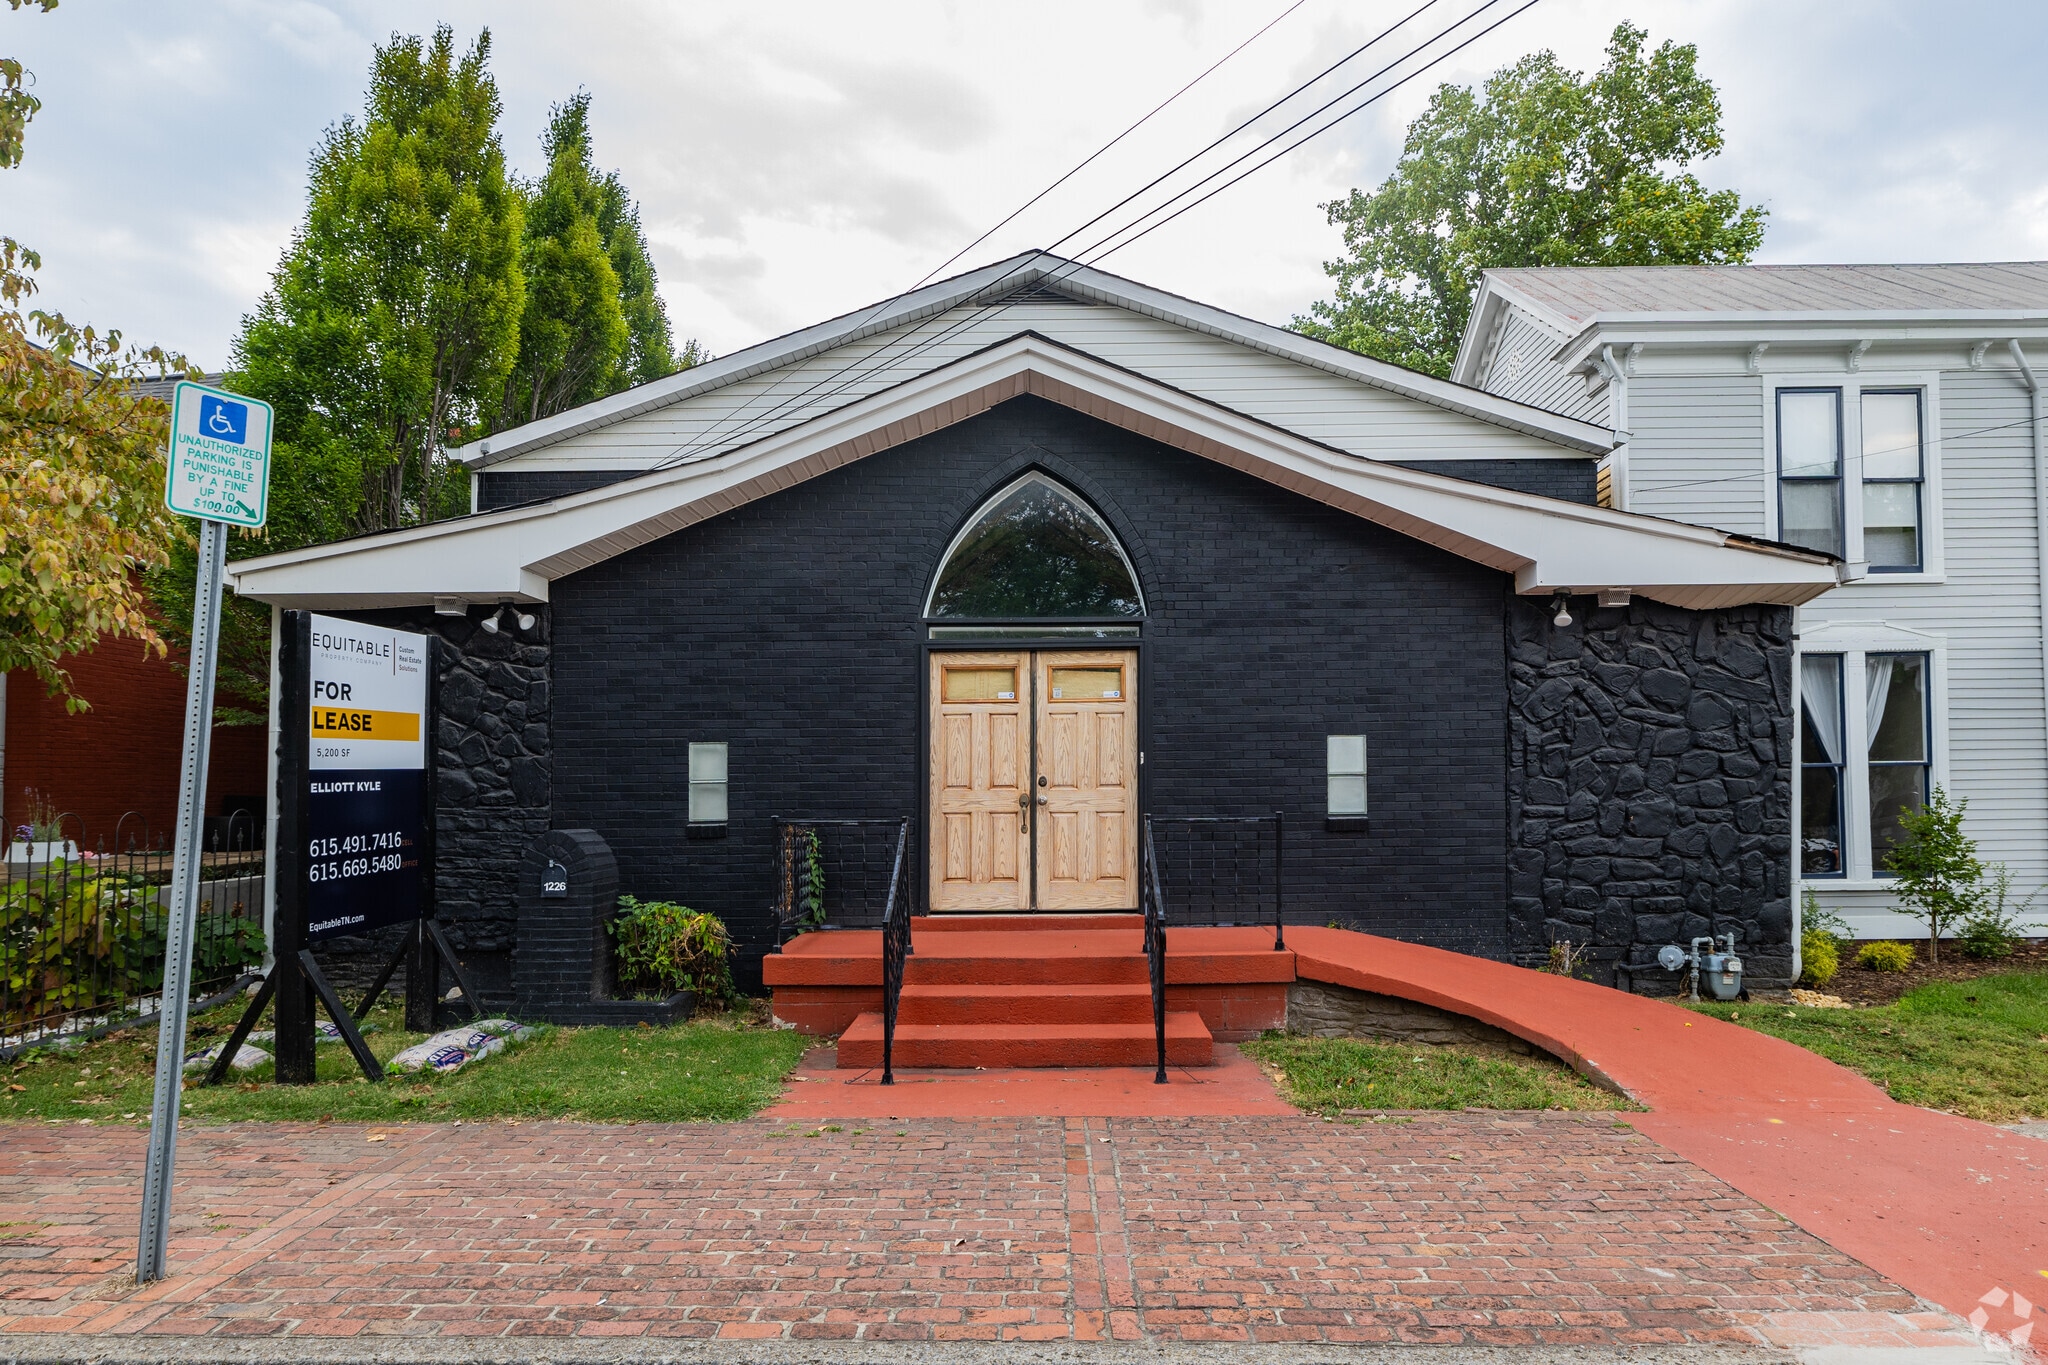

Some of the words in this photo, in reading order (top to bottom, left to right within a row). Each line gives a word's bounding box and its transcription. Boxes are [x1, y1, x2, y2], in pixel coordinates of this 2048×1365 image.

[178, 433, 263, 460] UNAUTHORIZED
[187, 447, 236, 467] PARKING
[242, 460, 252, 470] IS
[183, 459, 254, 482] PUNISHABLE
[188, 472, 204, 483] BY
[209, 477, 218, 487] A
[224, 481, 248, 493] FINE
[199, 486, 215, 497] UP
[222, 491, 235, 502] TO
[193, 497, 240, 515] $100.00
[312, 632, 390, 658] EQUITABLE
[314, 680, 352, 701] FOR
[313, 711, 372, 732] LEASE
[316, 748, 339, 758] 5,200
[341, 748, 351, 757] SF
[310, 782, 355, 793] ELLIOTT
[356, 781, 381, 792] KYLE
[309, 831, 401, 858] 615.491.7416
[309, 853, 401, 882] 615.669.5480
[543, 881, 567, 892] 1226
[309, 914, 365, 933] EquitableTN.com
